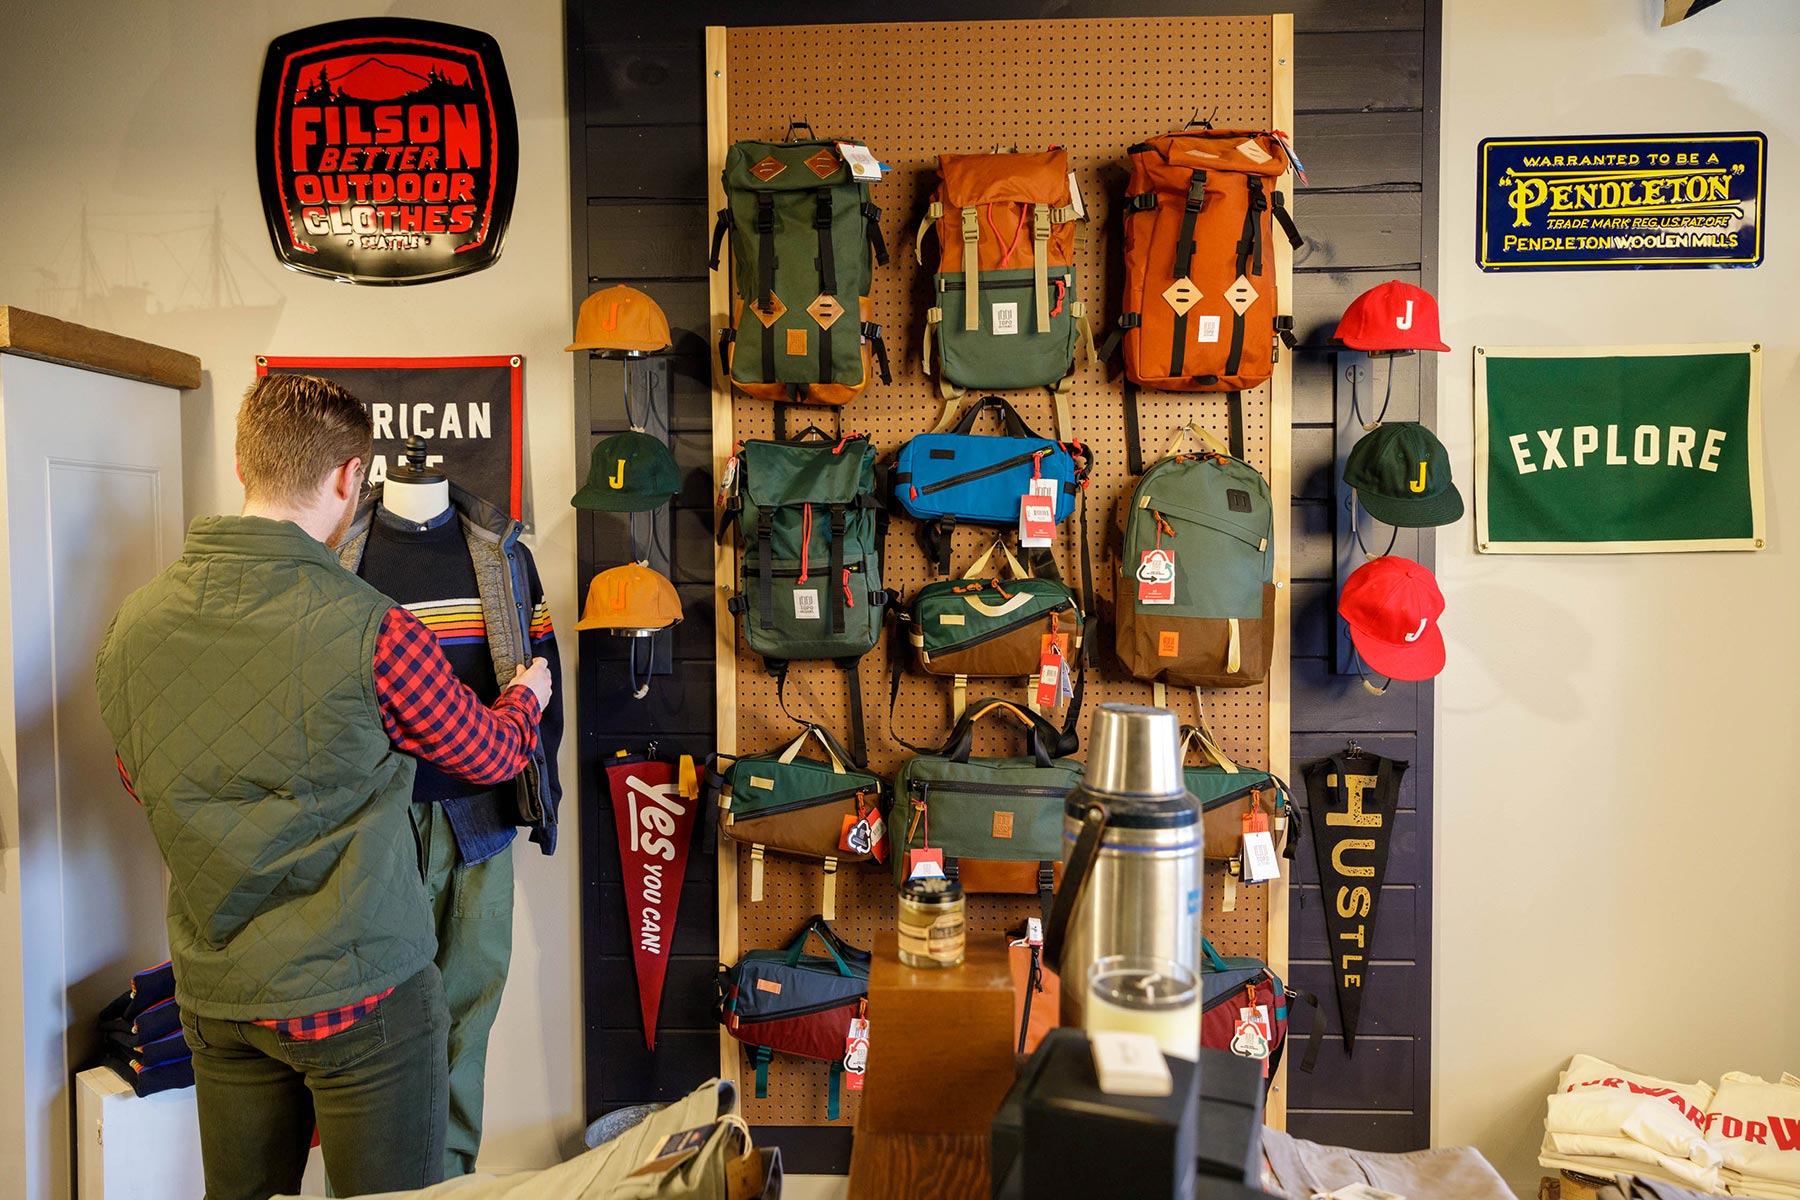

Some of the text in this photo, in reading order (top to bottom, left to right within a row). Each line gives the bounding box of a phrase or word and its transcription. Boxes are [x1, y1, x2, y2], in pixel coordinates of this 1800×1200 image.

[291, 104, 482, 172] FILSON
[318, 146, 440, 172] BETTER
[1523, 152, 1720, 168] WARRANTED TO BE A
[294, 172, 476, 204] OUTDOOR
[301, 204, 476, 235] CLOTHES
[1547, 218, 1588, 230] TRADE
[1591, 217, 1631, 229] MARK
[360, 235, 419, 250] SEATTLE
[1503, 234, 1738, 252] PENDLETON WOOLEN MILLS
[601, 302, 619, 331] J
[1396, 300, 1414, 330] J
[362, 402, 492, 440] RICAN
[1509, 424, 1727, 475] EXPLORE
[609, 459, 626, 489] J
[1409, 461, 1428, 493] J
[610, 579, 628, 611] J
[1403, 617, 1428, 642] J
[643, 863, 662, 905] YOU
[1326, 774, 1383, 988] HUSTLE
[640, 907, 662, 955] CAN!
